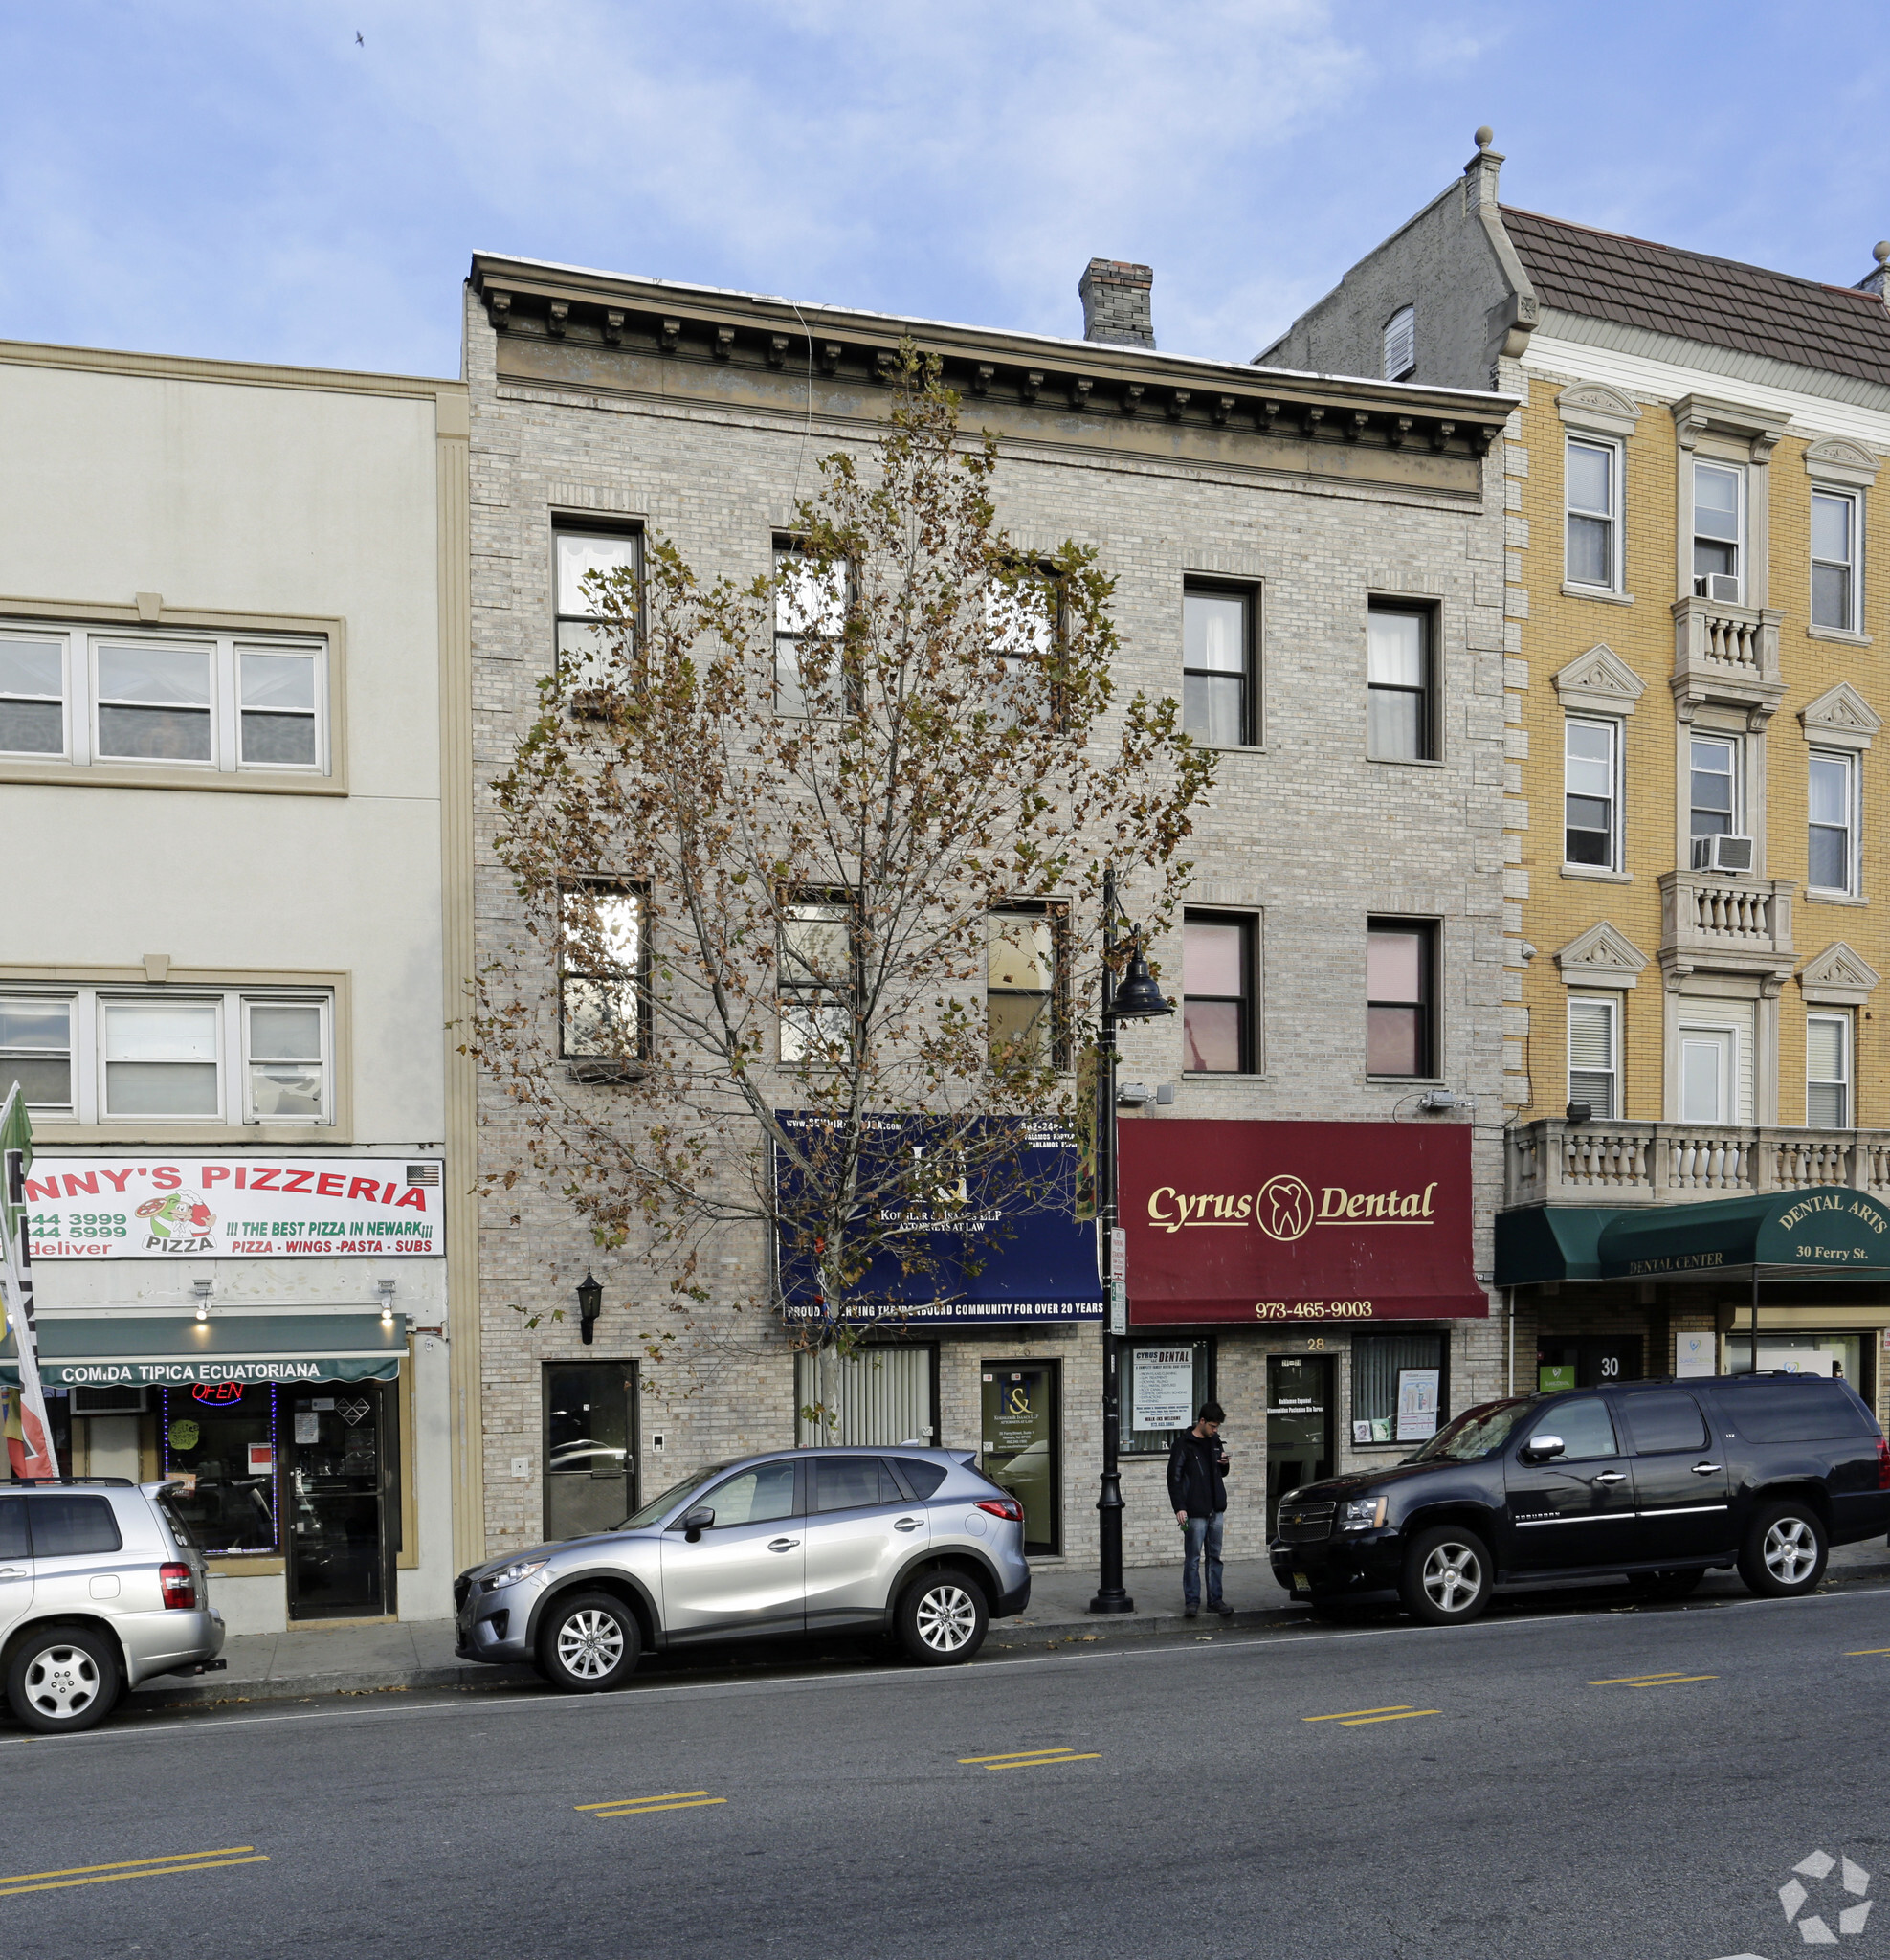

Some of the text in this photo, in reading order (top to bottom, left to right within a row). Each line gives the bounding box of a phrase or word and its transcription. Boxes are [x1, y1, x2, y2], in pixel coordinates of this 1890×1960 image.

[201, 1166, 427, 1212] PIZZERIA
[1148, 1182, 1438, 1233] Cyrus Dental
[1778, 1194, 1888, 1234] DENTAL ARTS
[69, 1214, 127, 1225] 3999
[980, 1210, 1002, 1221] LLP
[69, 1226, 127, 1238] 5999
[242, 1222, 268, 1236] THE
[272, 1222, 305, 1236] BEST
[308, 1221, 345, 1236] PIZZA
[349, 1221, 364, 1236] IN
[952, 1222, 964, 1232] AT
[965, 1222, 986, 1232] LAW
[29, 1241, 113, 1255] deliver
[146, 1236, 214, 1253] PIZZA
[232, 1240, 273, 1254] PIZZA
[286, 1240, 332, 1253] WINGS
[395, 1239, 432, 1253] SUBS
[1796, 1245, 1869, 1261] 30 Ferry St.
[1630, 1252, 1723, 1275] DENTAL CENTER
[788, 1304, 824, 1318] PROUD
[955, 1303, 1012, 1315] COMMUNITY
[1014, 1303, 1033, 1314] FOR
[1034, 1303, 1059, 1314] OVER
[1061, 1303, 1073, 1314] 20
[1075, 1303, 1103, 1314] YEARS
[1256, 1301, 1373, 1318] 973-465-9003
[1307, 1338, 1324, 1350] 28
[1159, 1351, 1189, 1363] DENTAL
[139, 1365, 194, 1380] TIPICA
[199, 1363, 321, 1379] ECUATORIANA
[1601, 1357, 1619, 1376] 30
[1515, 1511, 1560, 1521] SUBURBAN
